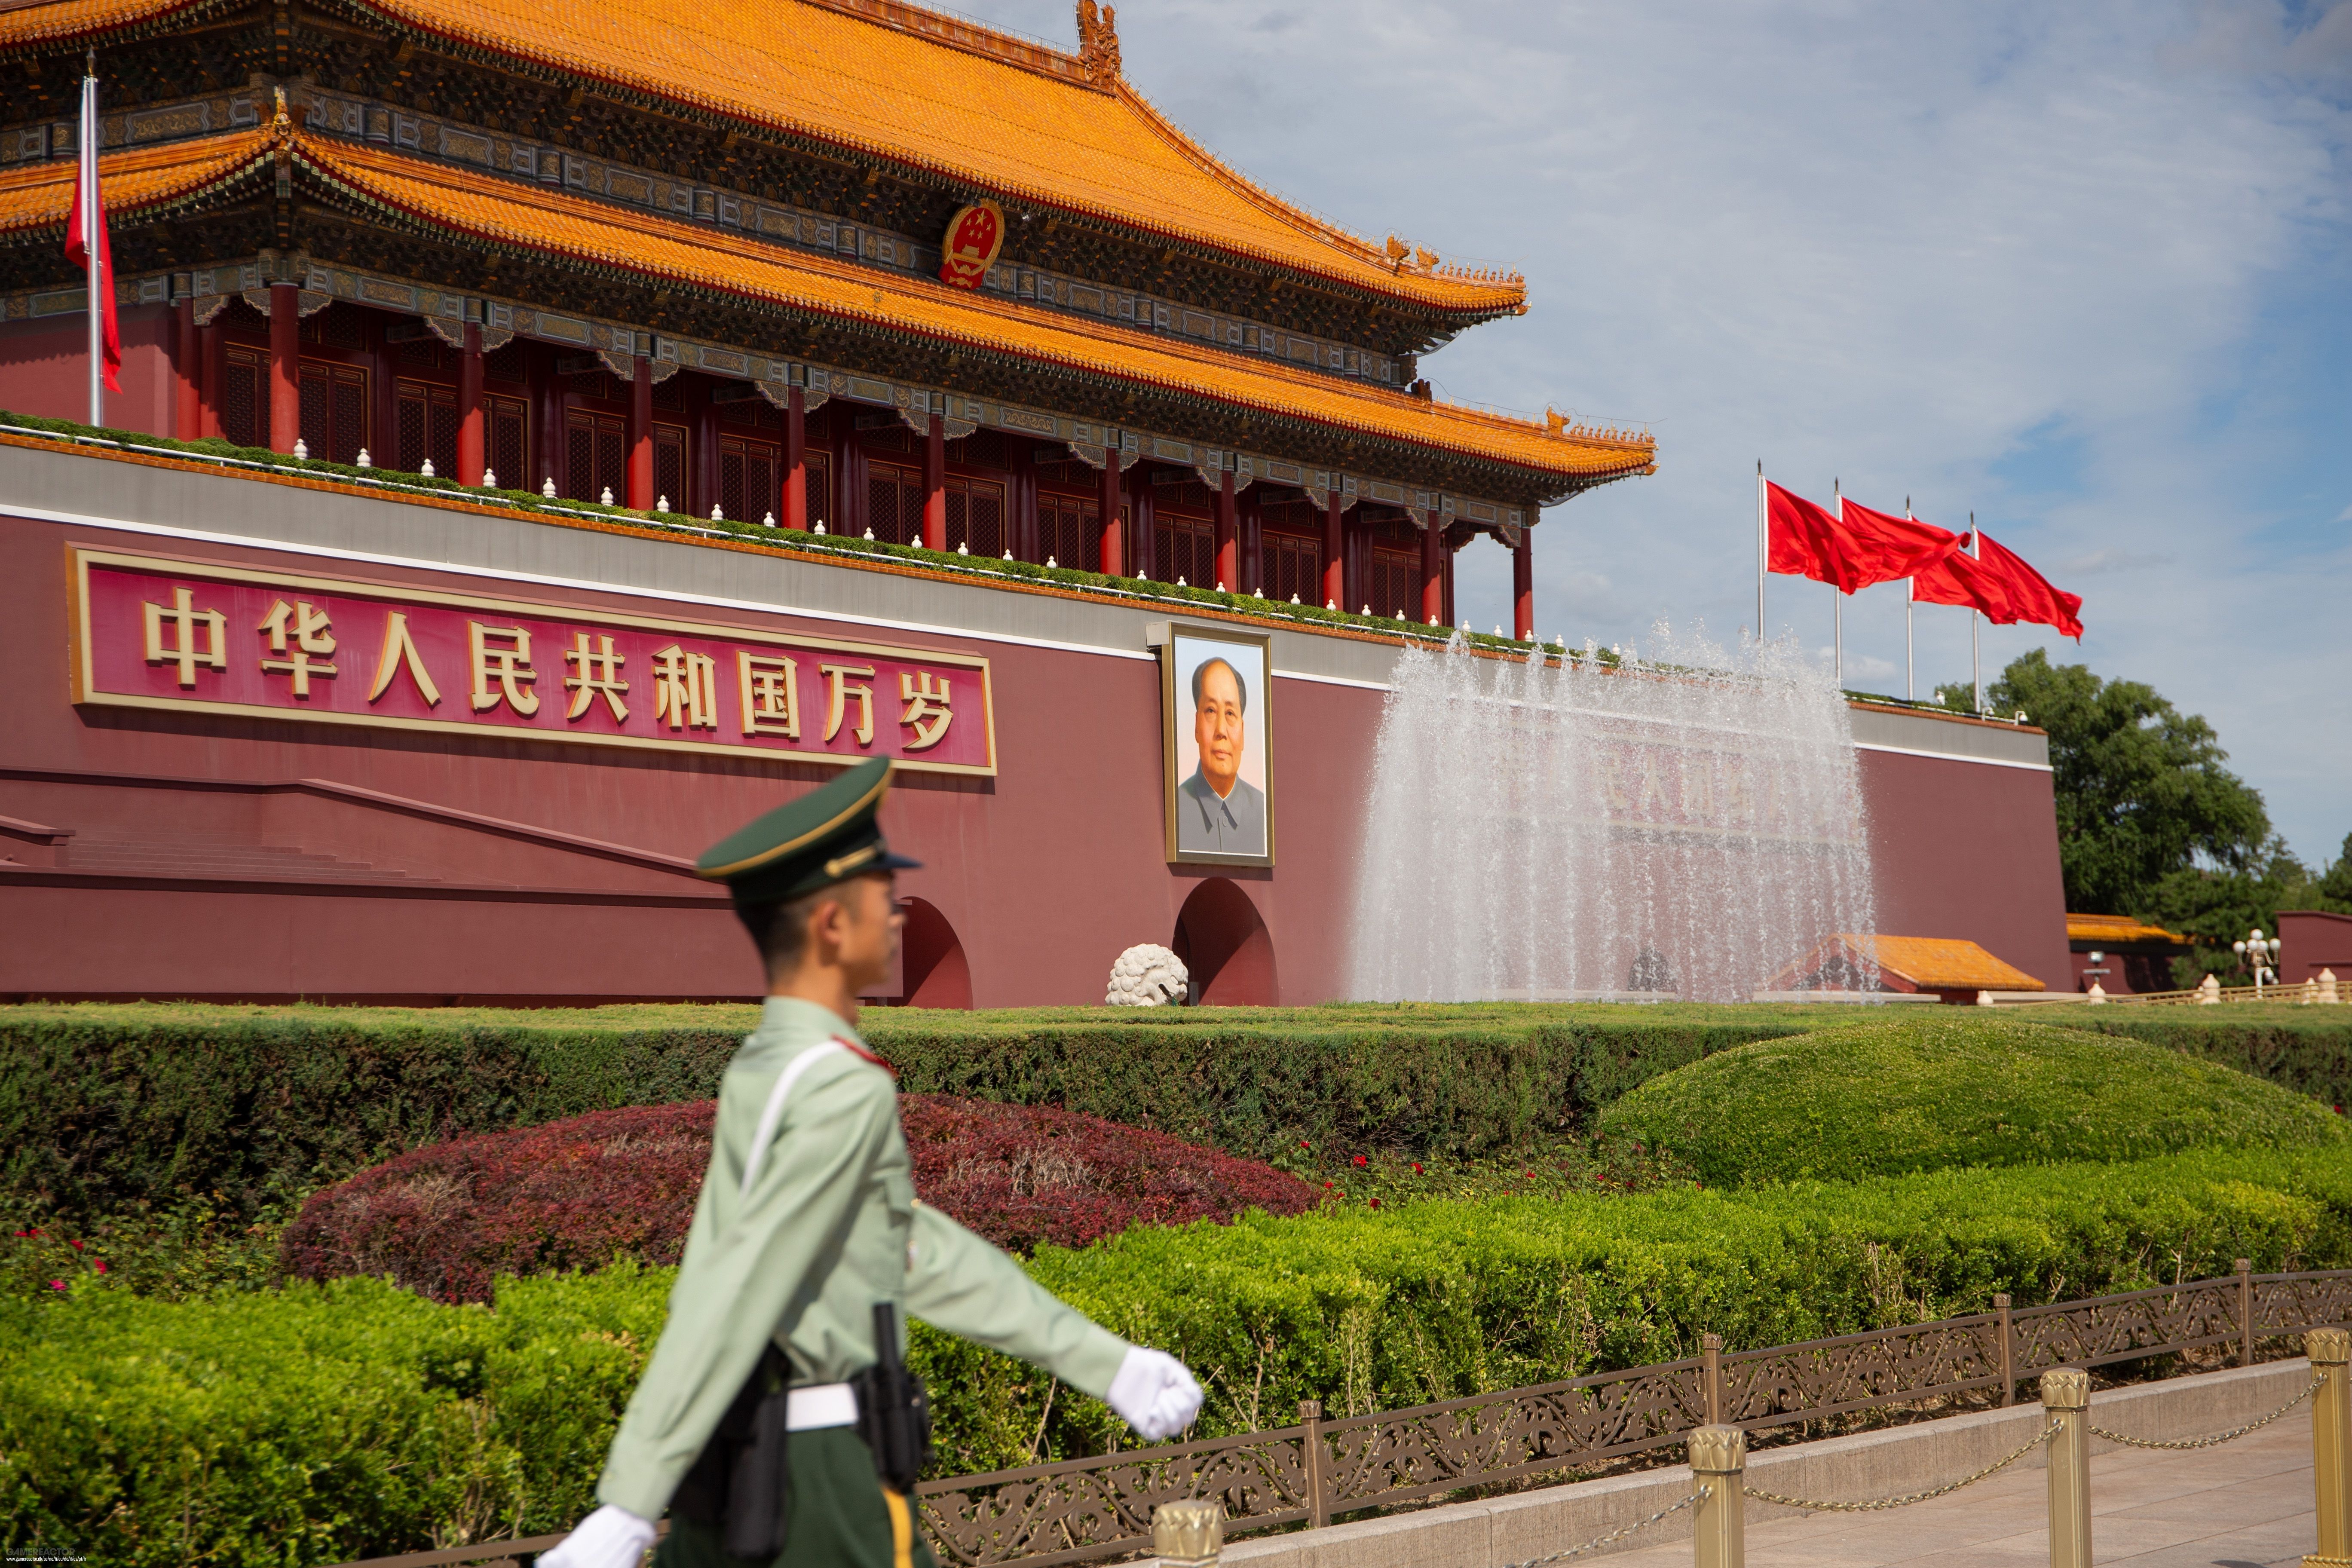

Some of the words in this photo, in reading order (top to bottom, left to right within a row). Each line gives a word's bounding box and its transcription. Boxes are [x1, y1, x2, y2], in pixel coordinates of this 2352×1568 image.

[142, 587, 953, 750] 中华人民共和国万岁
